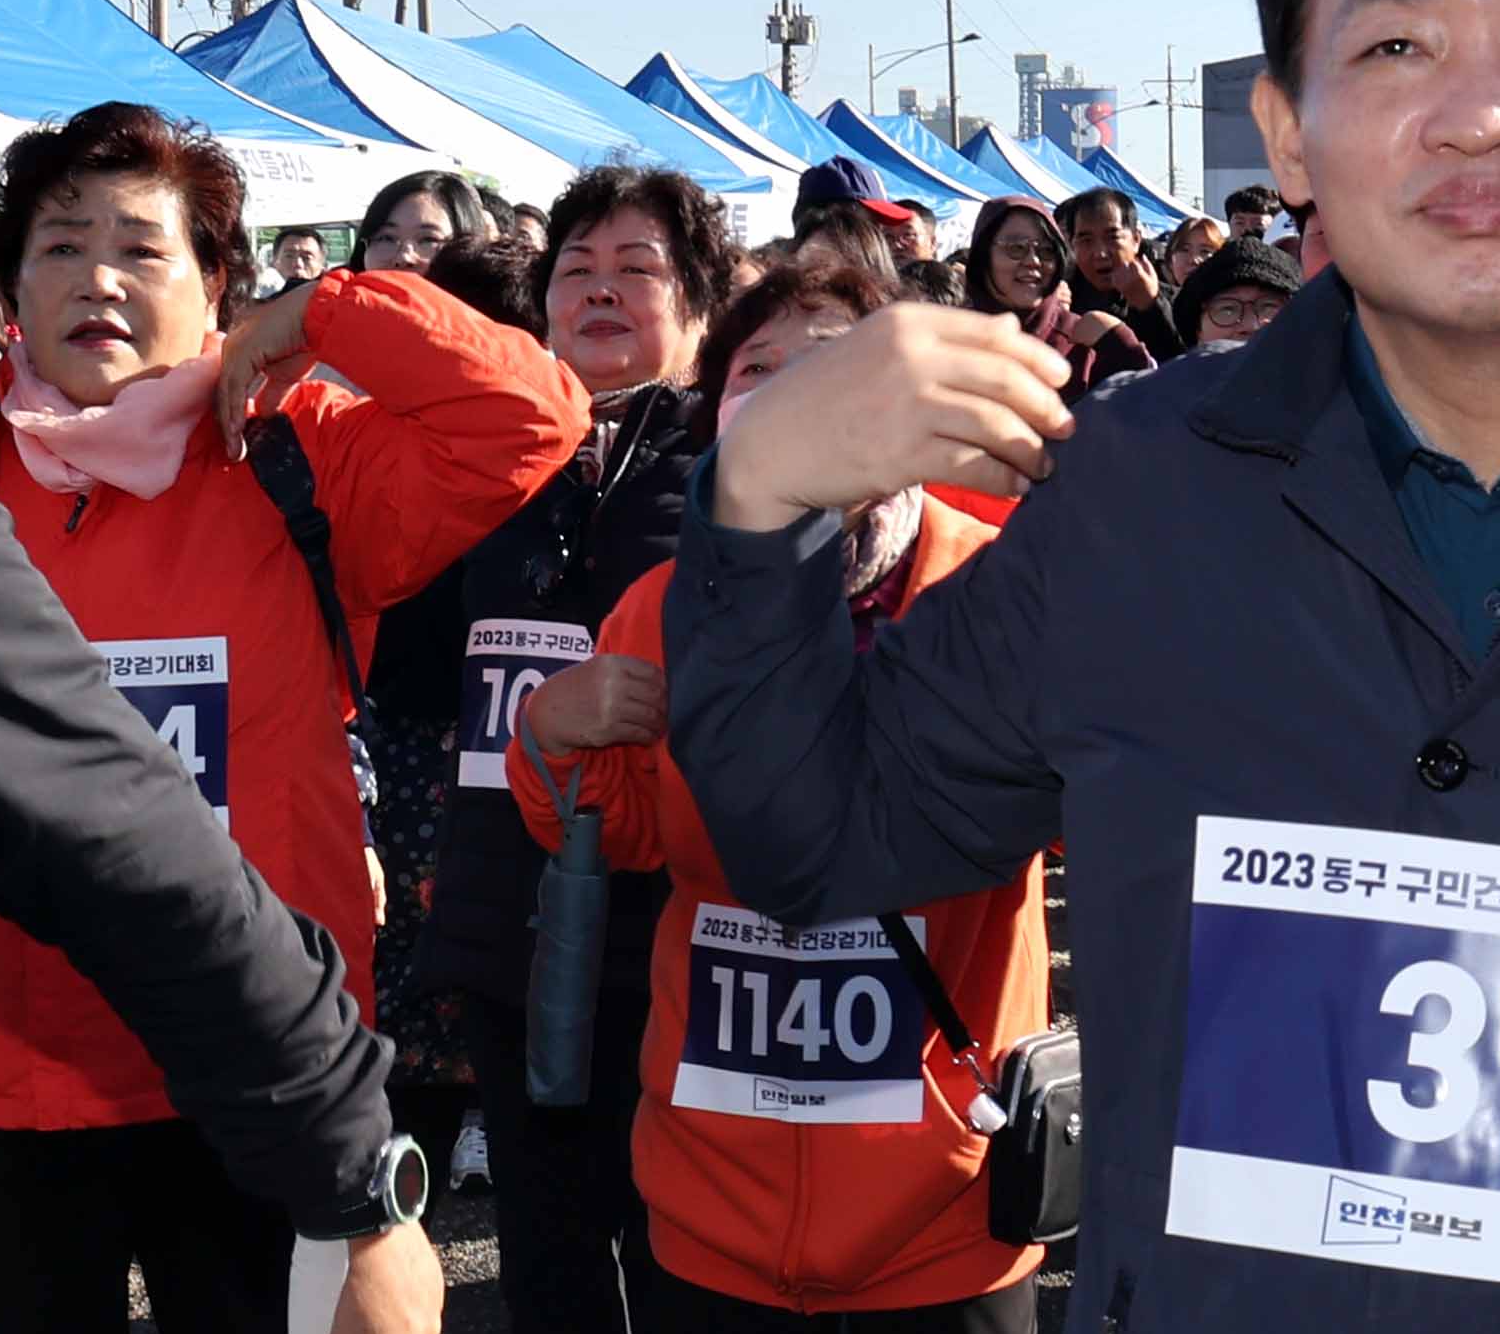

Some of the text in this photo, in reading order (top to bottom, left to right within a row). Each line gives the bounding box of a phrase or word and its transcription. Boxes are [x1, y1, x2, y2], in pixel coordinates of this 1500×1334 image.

[474, 631, 594, 653] 2023 동구 구민건
[107, 654, 214, 675] 강걷기대회
[1221, 846, 1314, 888] 2023
[1323, 857, 1388, 898] 동구
[702, 918, 738, 939] 2023
[740, 924, 770, 944] 동구
[712, 966, 893, 1065] 1140
[1366, 958, 1487, 1145] 3
[1338, 1199, 1483, 1242] 인천일보
